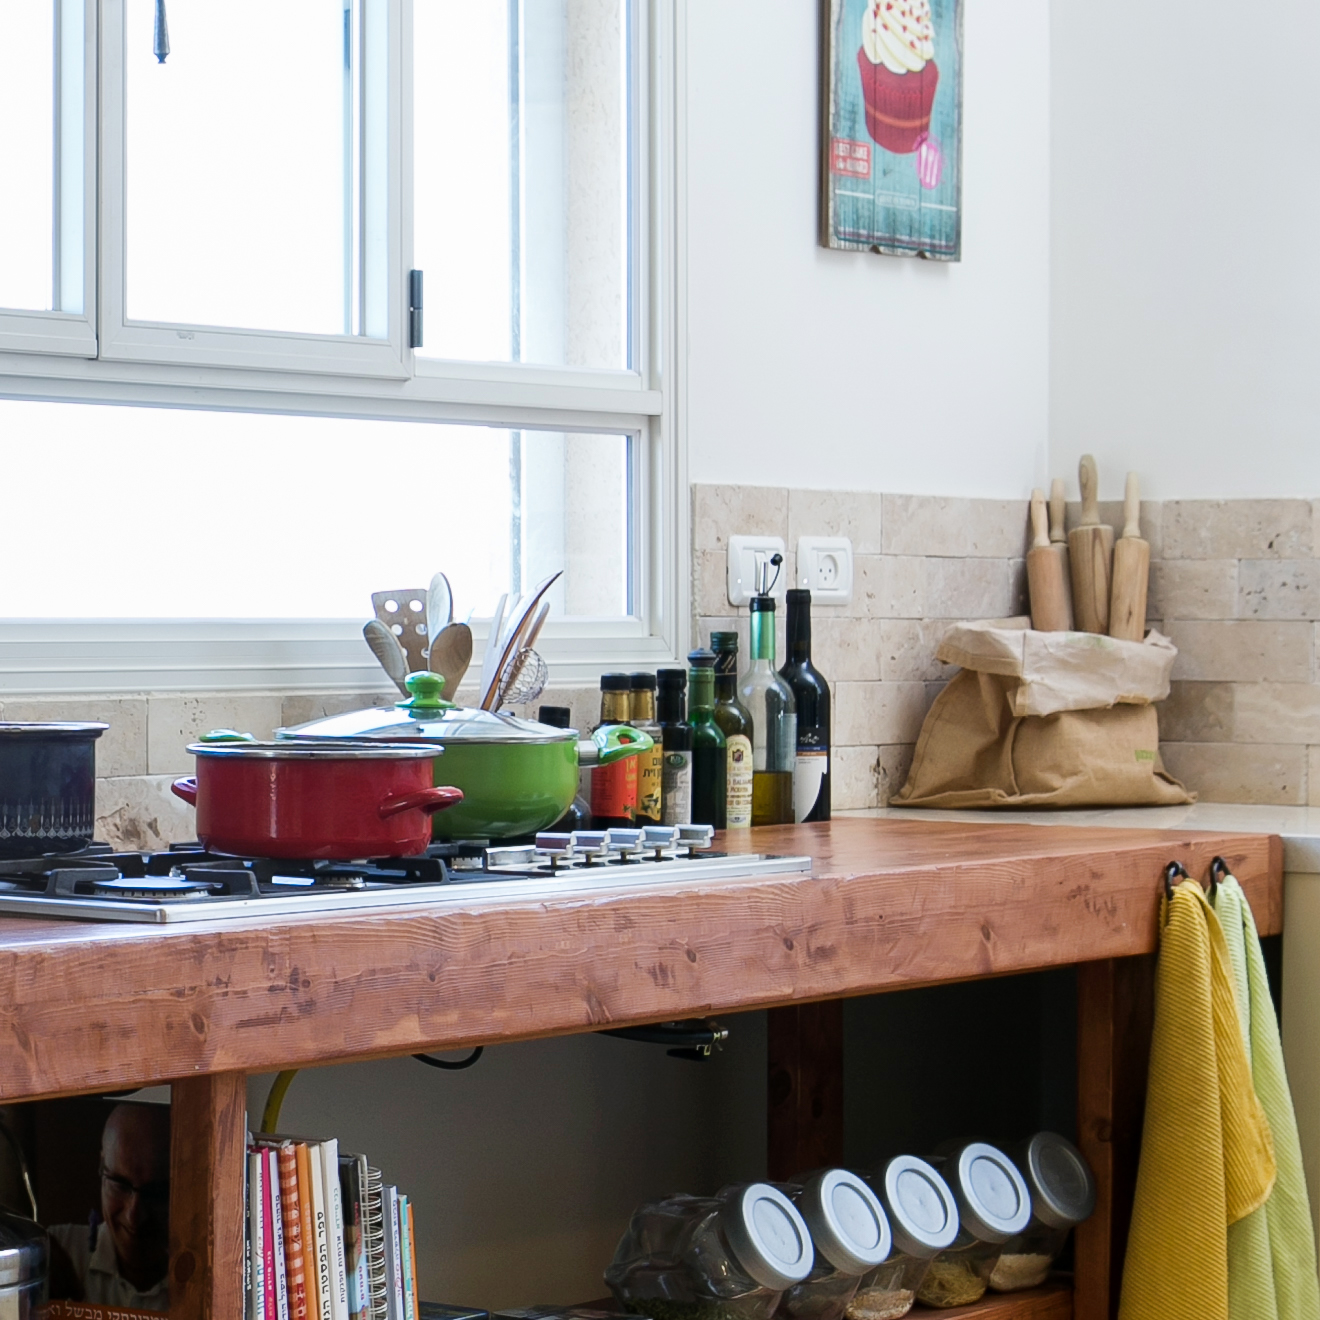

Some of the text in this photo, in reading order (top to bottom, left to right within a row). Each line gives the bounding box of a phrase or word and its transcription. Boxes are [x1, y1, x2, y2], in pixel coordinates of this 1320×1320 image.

[317, 1211, 325, 1239] ספר
[319, 1243, 329, 1295] הפסטה
[65, 1299, 103, 1320] מבשל
